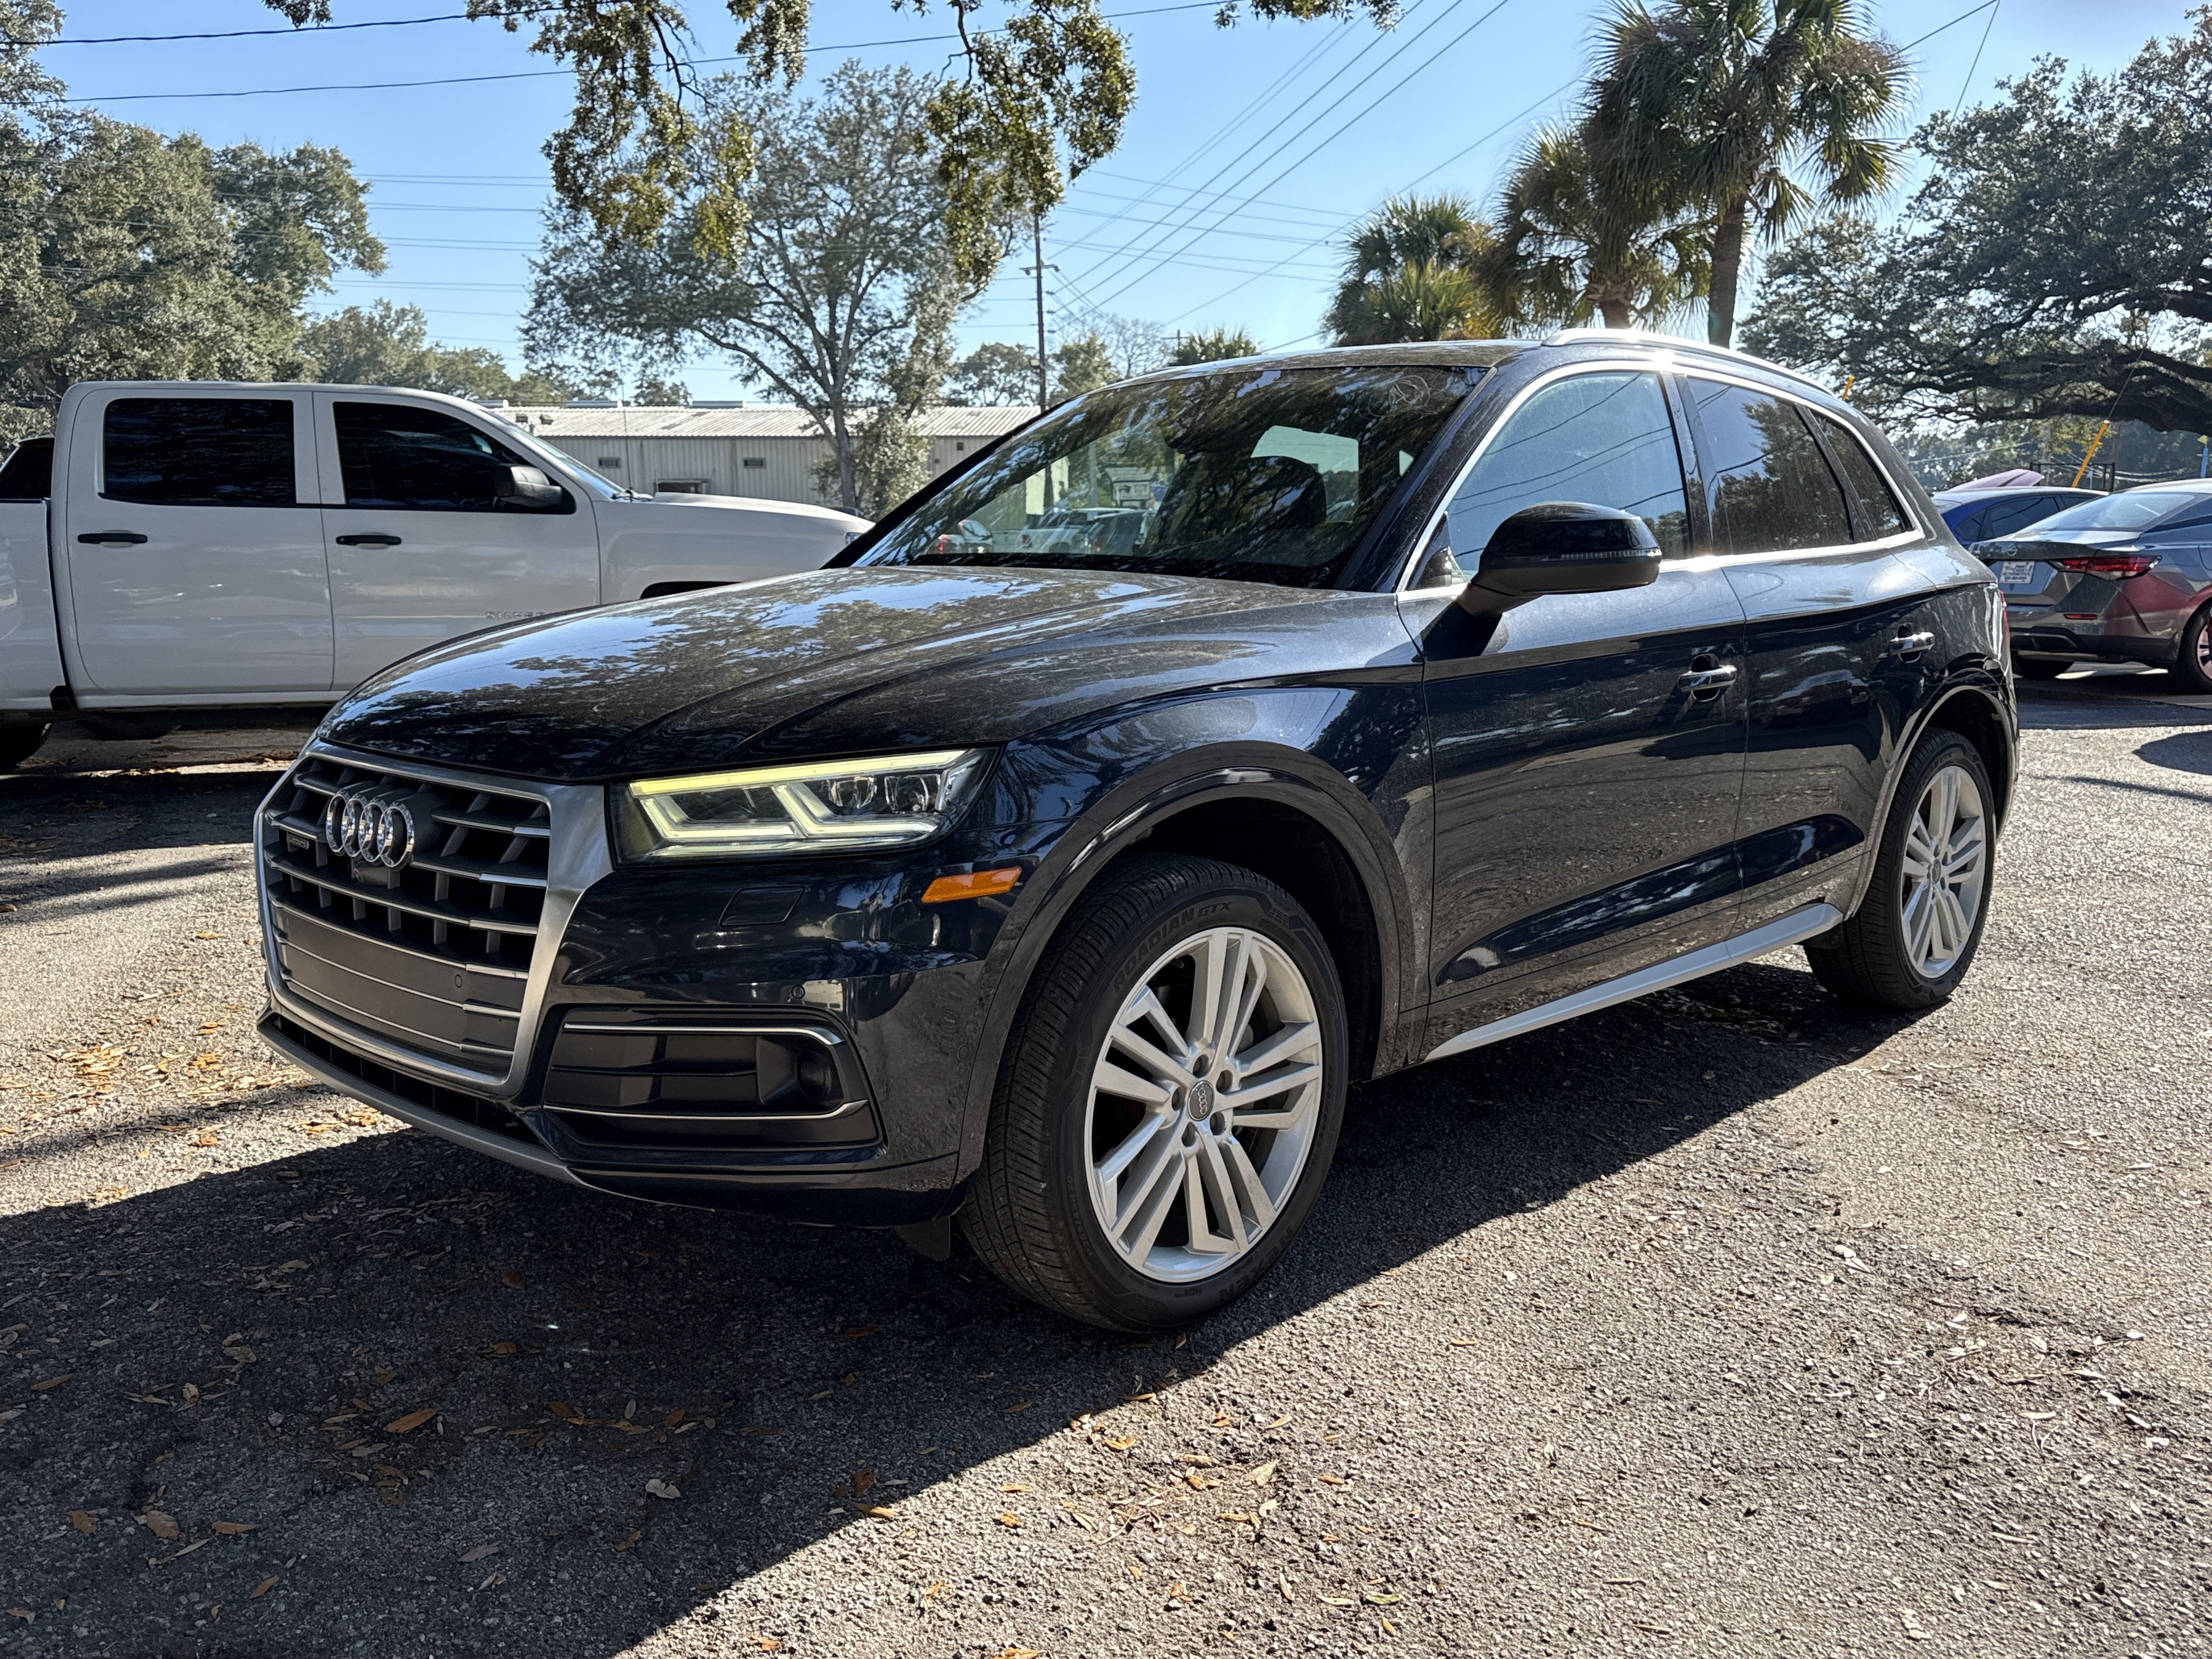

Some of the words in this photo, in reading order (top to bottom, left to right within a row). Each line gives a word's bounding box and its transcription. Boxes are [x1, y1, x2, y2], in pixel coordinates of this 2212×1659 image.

[1114, 909, 1194, 992] ROADIAN
[1198, 902, 1232, 917] GTX
[1220, 1226, 1293, 1302] NEXEN
